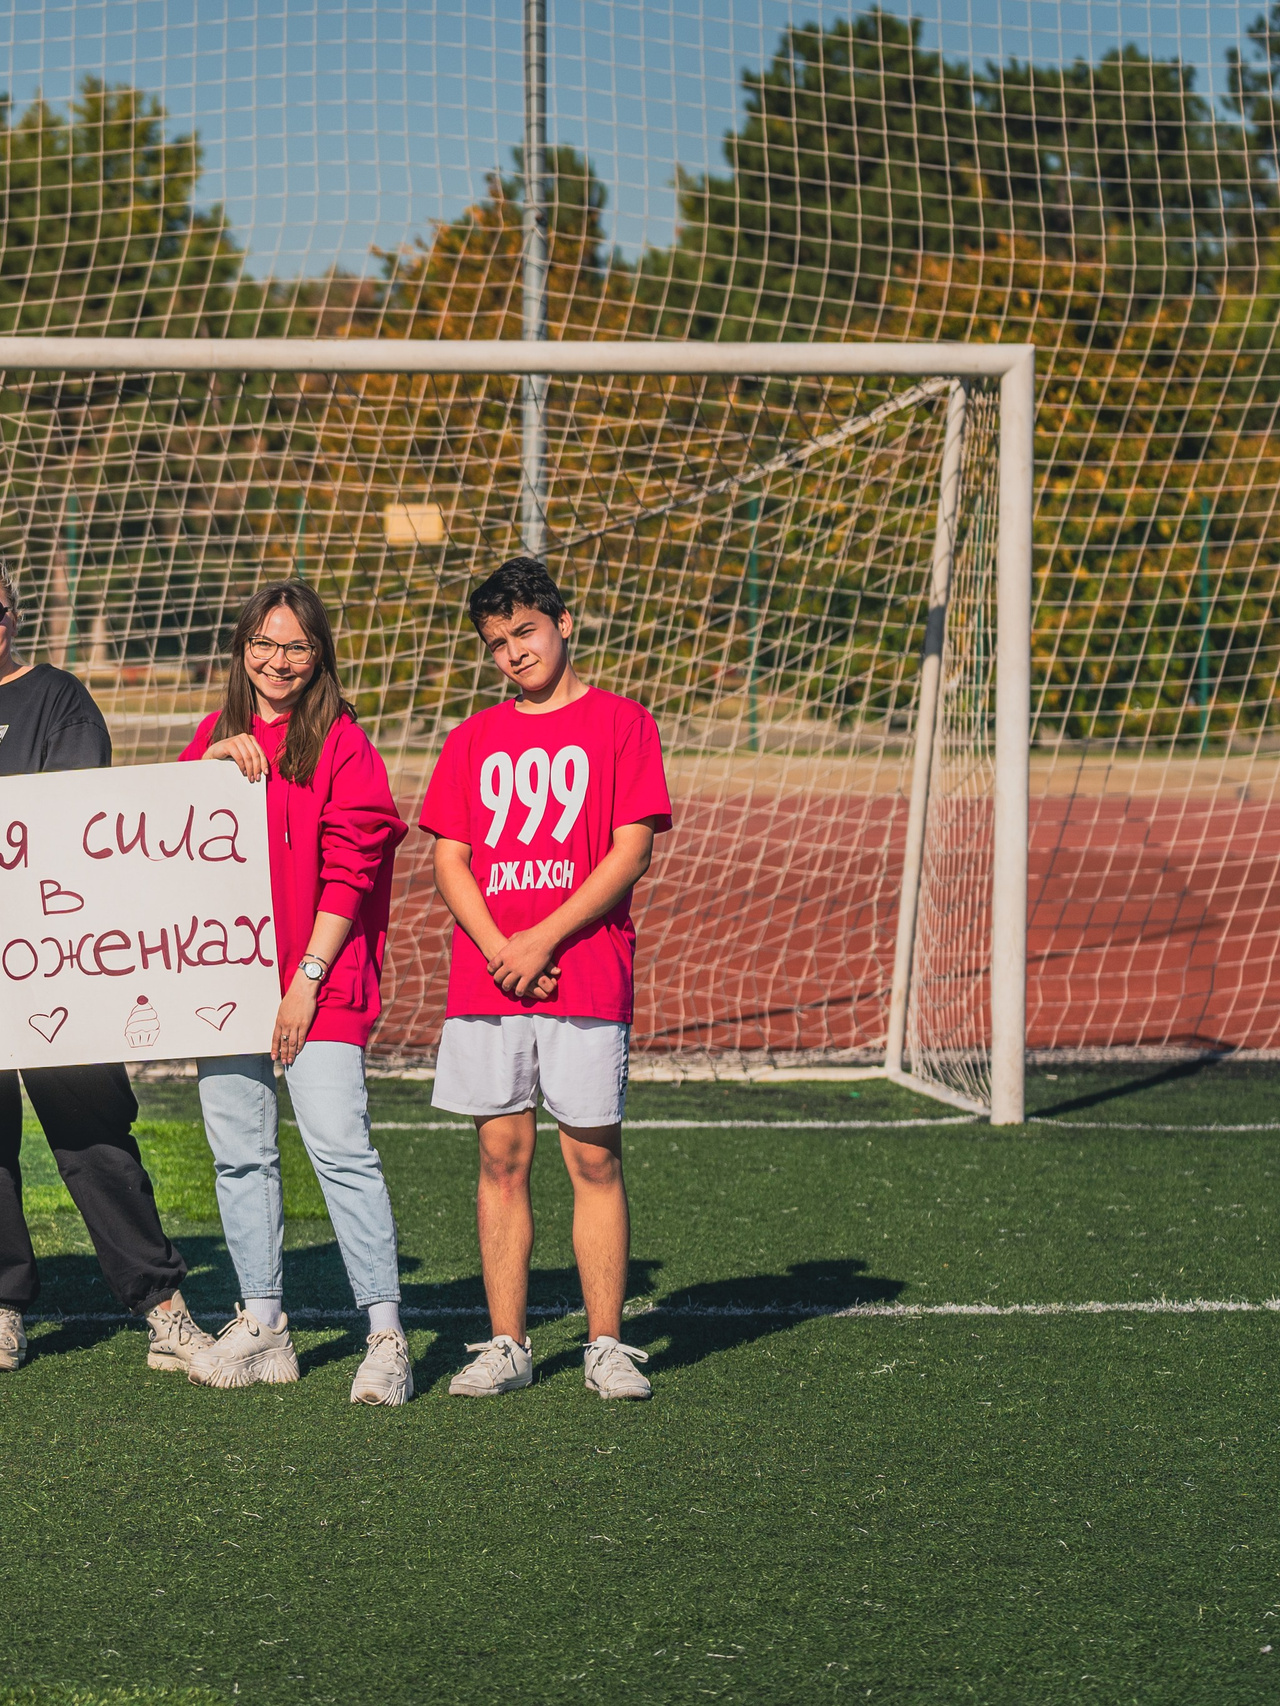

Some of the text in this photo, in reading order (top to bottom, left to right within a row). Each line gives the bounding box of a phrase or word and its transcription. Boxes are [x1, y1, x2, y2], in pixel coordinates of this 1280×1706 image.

[480, 745, 589, 848] 999
[83, 805, 247, 863] сила
[486, 859, 575, 896] ДЖАХОН
